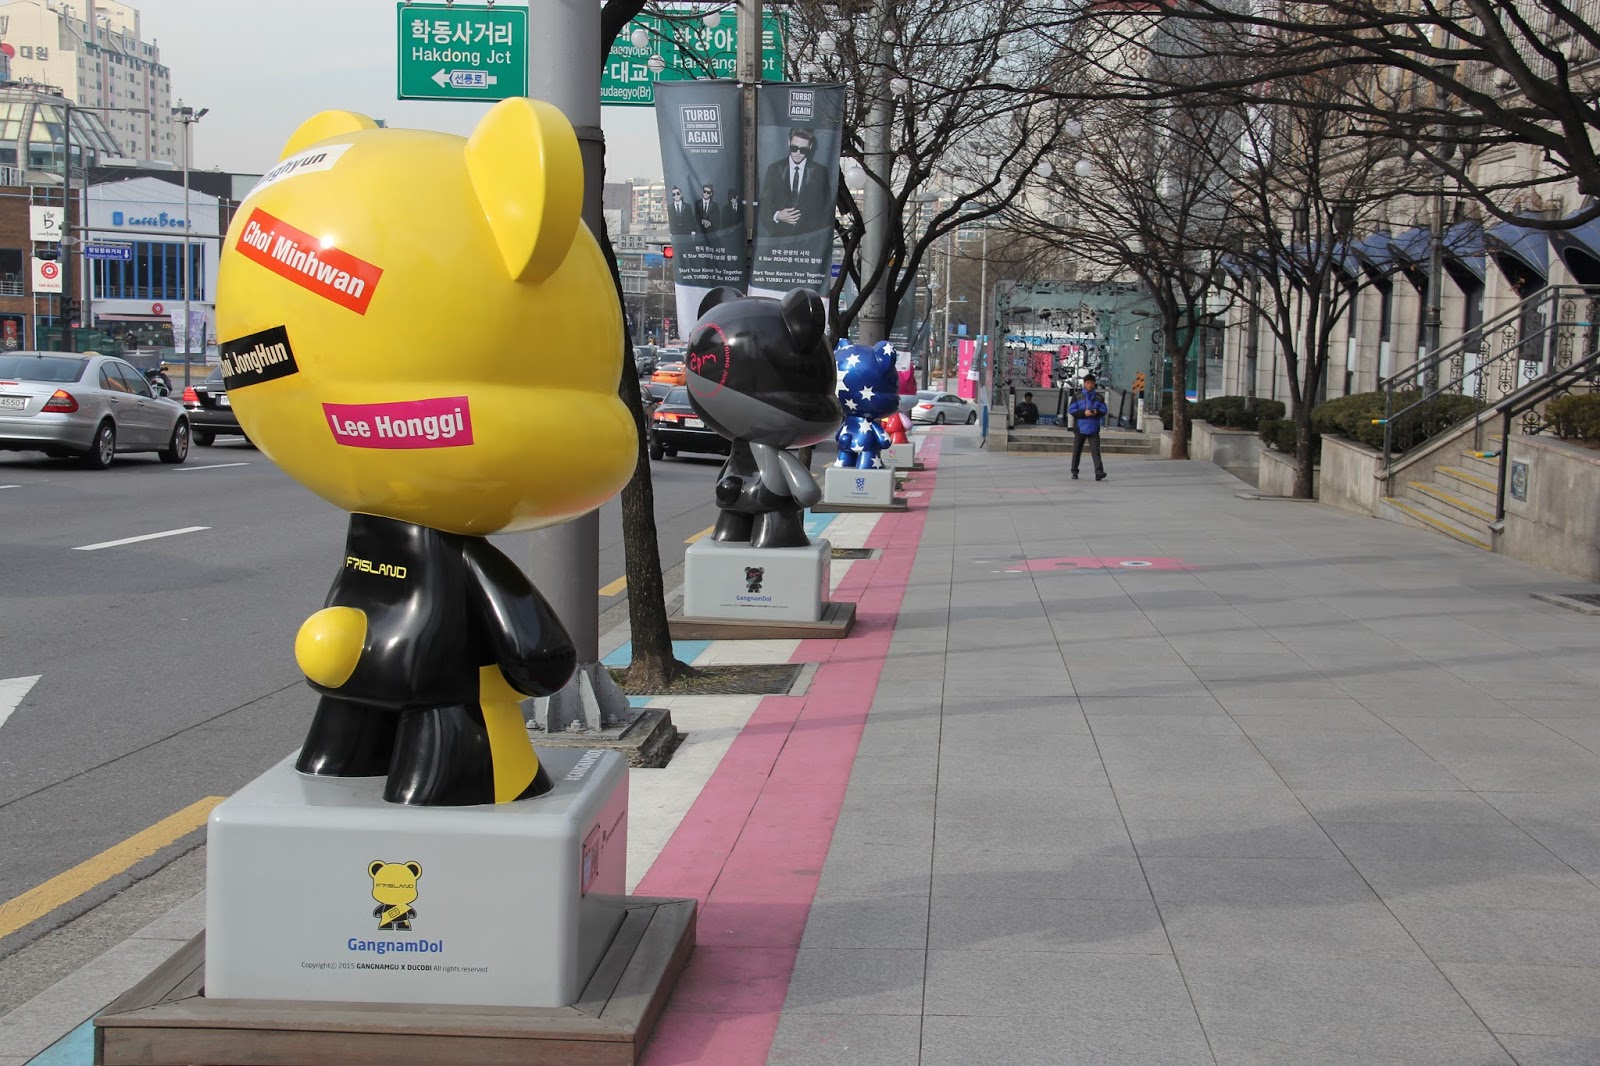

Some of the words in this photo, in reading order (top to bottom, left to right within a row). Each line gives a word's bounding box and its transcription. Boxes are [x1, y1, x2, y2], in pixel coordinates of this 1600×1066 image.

[411, 19, 512, 46] 학동사거리
[20, 46, 48, 61] 대원
[412, 47, 480, 66] Hakdong
[486, 50, 511, 64] Jct
[792, 92, 812, 101] TURBO
[684, 109, 716, 121] TURBO
[791, 106, 811, 115] AGAIN
[688, 131, 718, 144] AGAIN
[243, 220, 276, 254] Choi
[272, 235, 365, 298] Minhwan
[232, 342, 288, 374] JongHun
[331, 414, 370, 438] Lee
[374, 408, 464, 440] Honggi
[348, 938, 443, 954] GangnamDol
